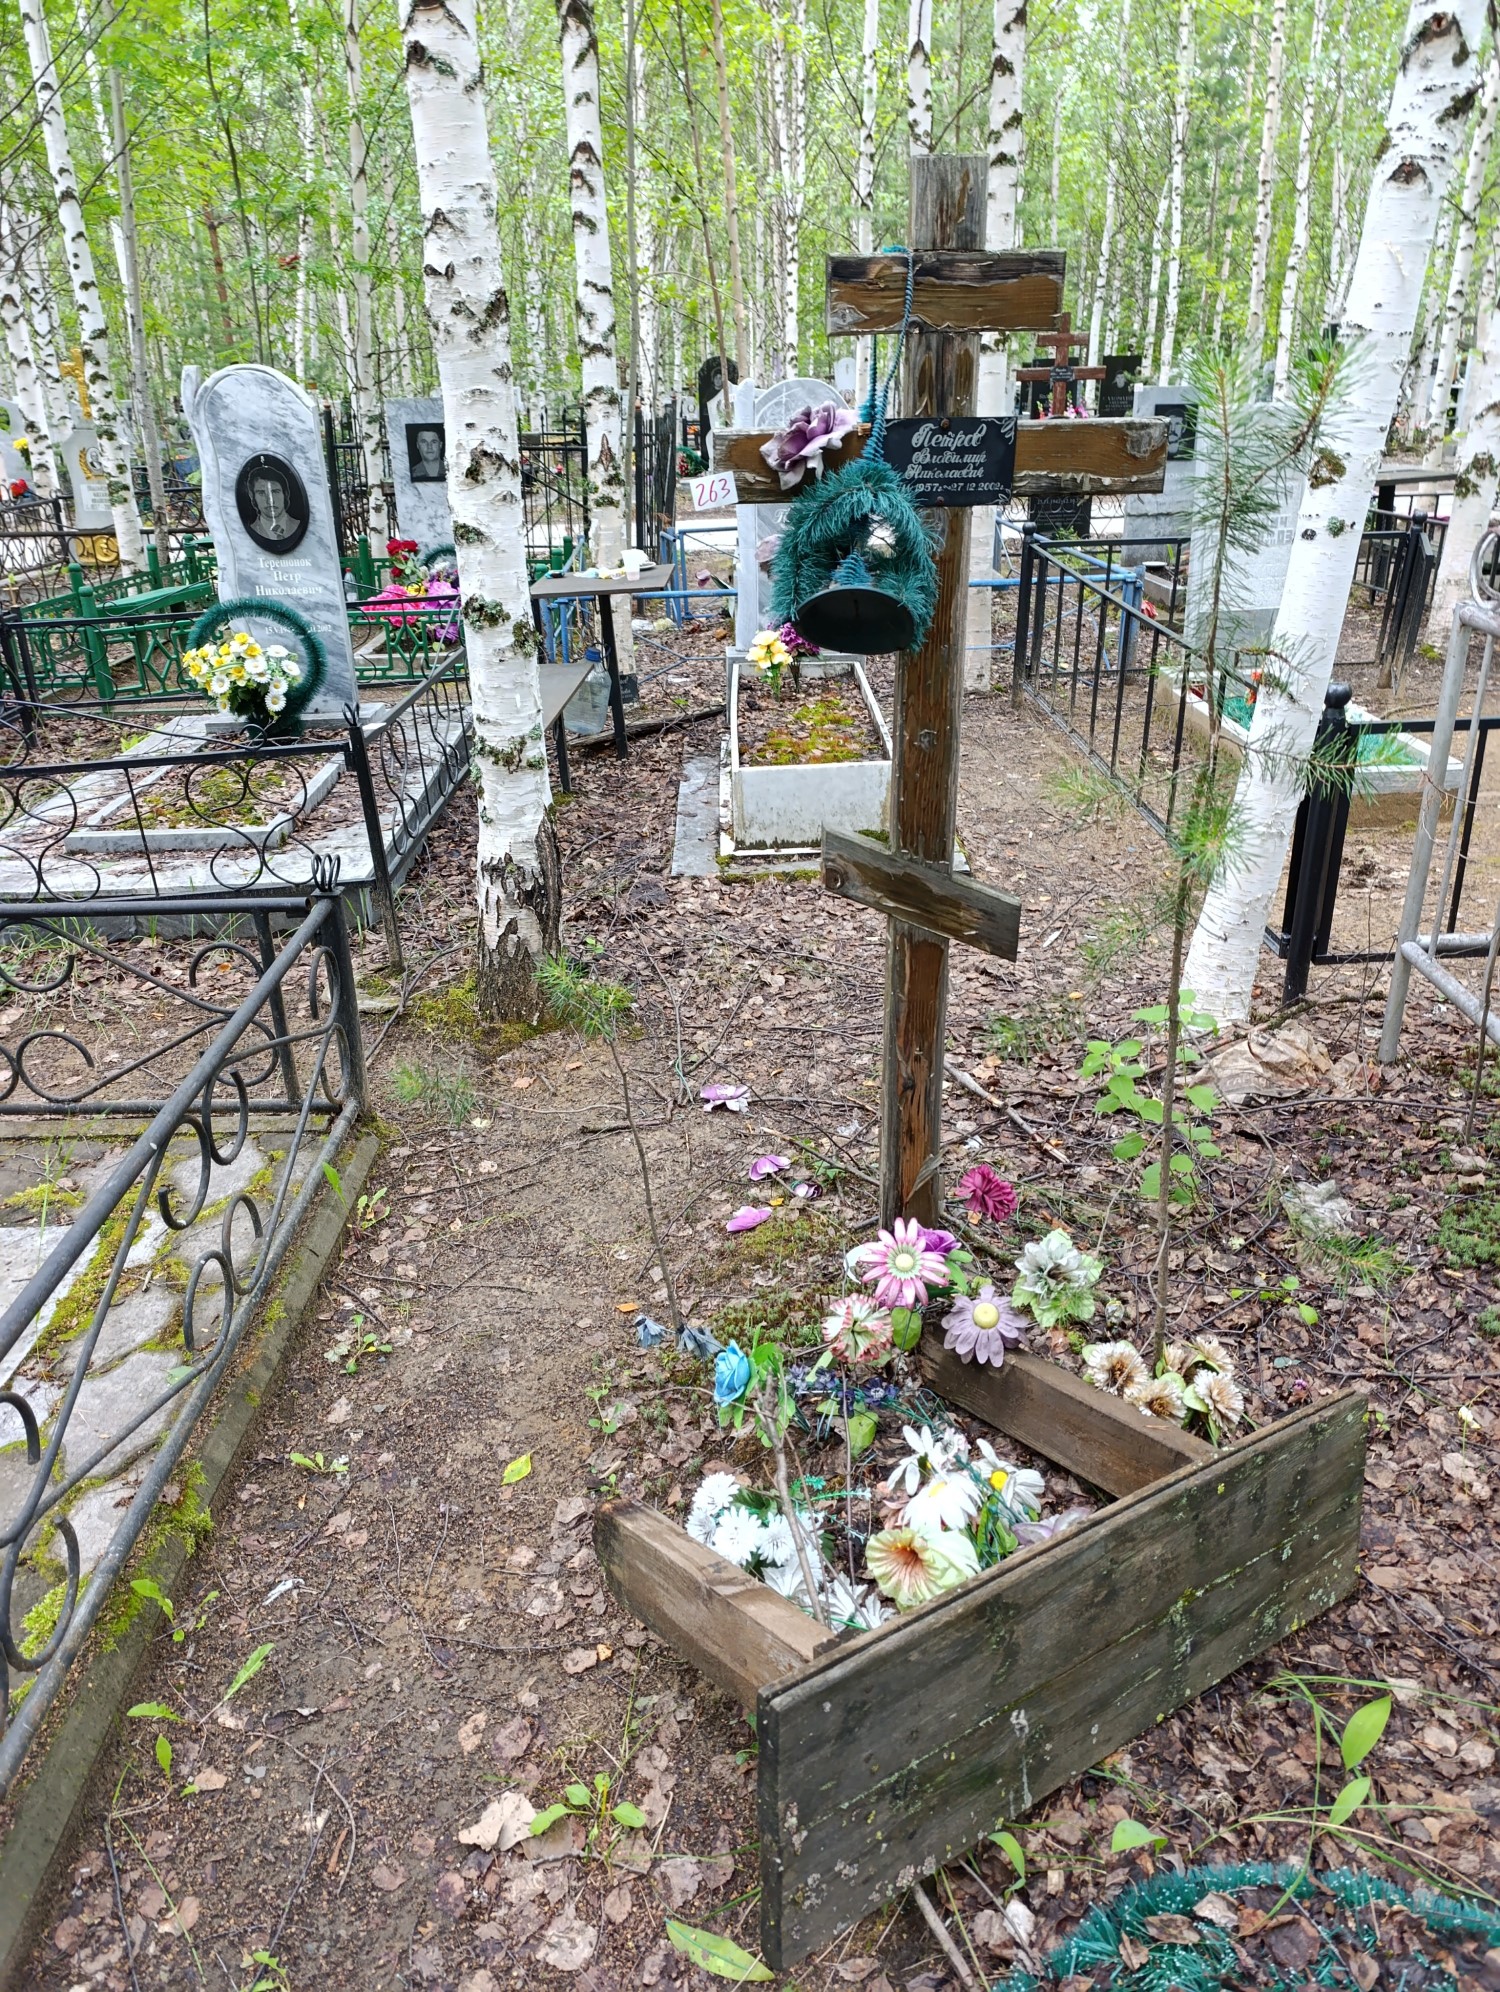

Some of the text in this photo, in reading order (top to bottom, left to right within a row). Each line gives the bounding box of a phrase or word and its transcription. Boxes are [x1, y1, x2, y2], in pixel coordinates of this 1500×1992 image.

[911, 423, 987, 450] Петров
[911, 448, 987, 466] Владимир
[695, 478, 731, 507] 263
[273, 571, 302, 583] Петр
[255, 584, 322, 596] Николаевич
